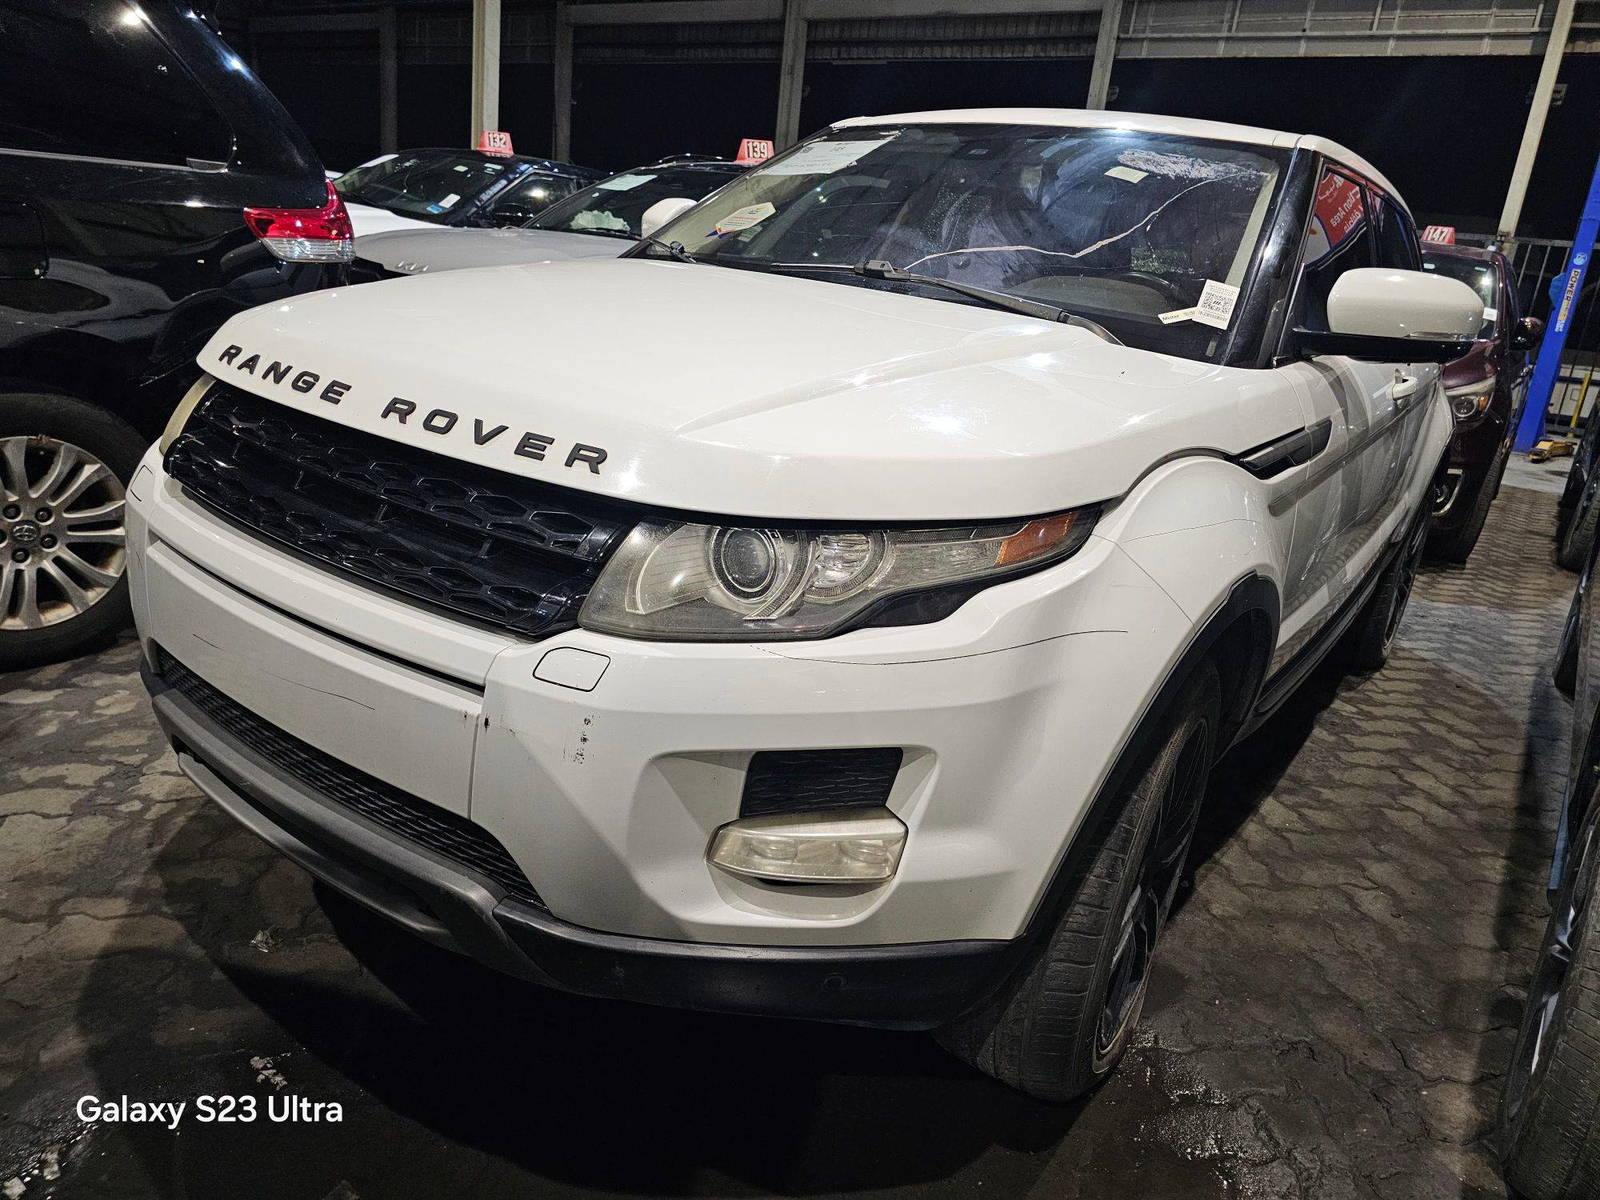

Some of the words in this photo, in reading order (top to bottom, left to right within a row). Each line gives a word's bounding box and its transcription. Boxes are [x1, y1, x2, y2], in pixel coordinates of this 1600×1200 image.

[487, 132, 508, 148] 132
[746, 141, 769, 159] 139
[1425, 226, 1449, 242] 147
[218, 344, 353, 406] RANGE
[380, 396, 608, 475] ROVER
